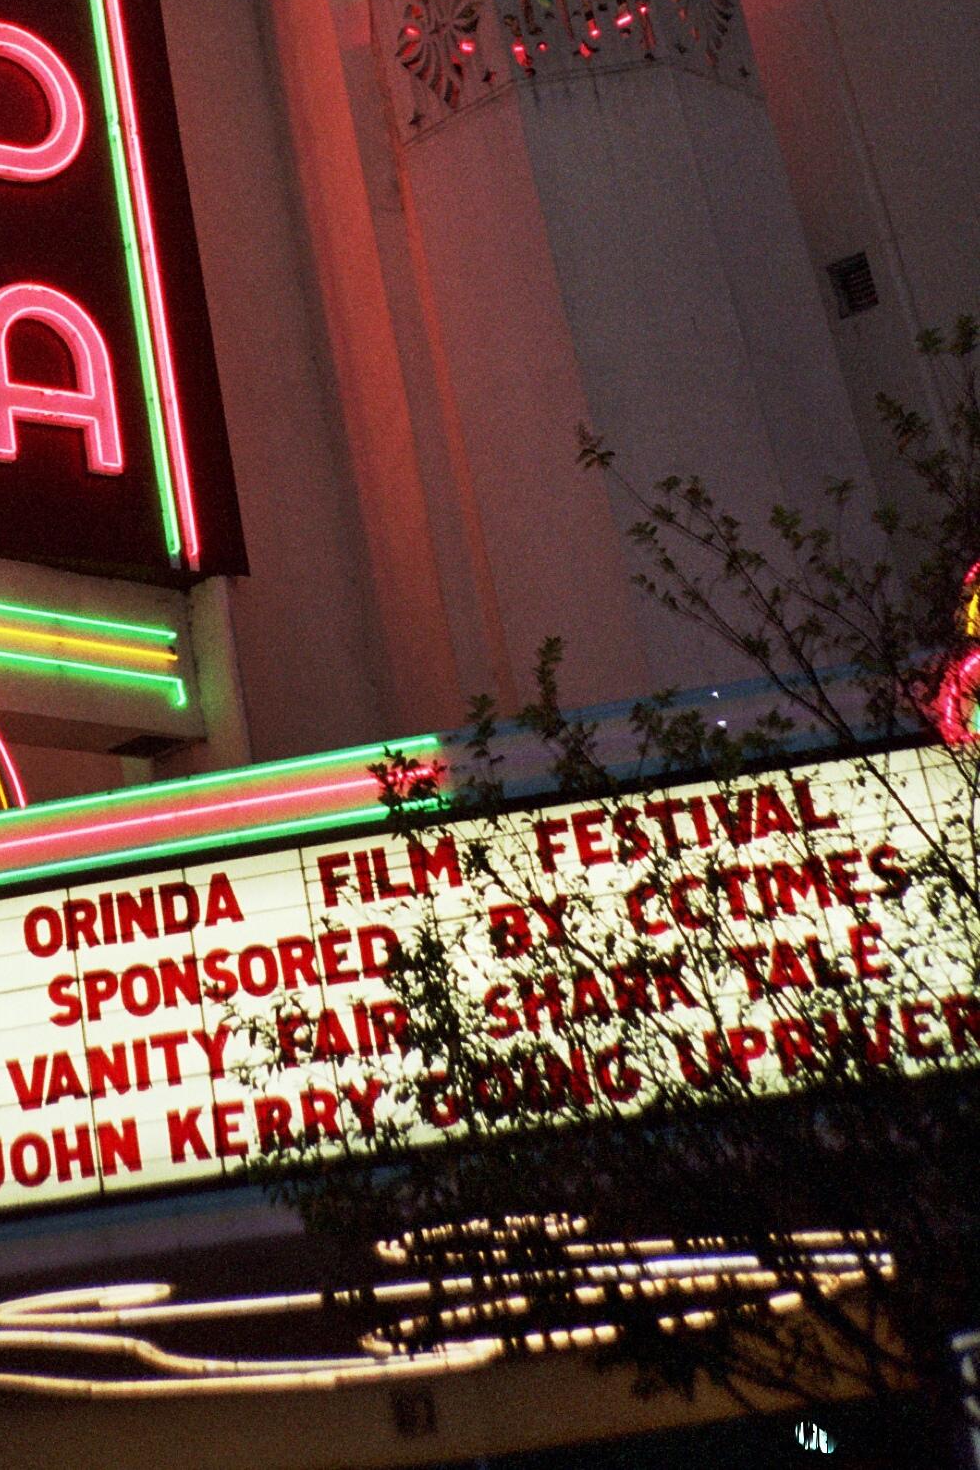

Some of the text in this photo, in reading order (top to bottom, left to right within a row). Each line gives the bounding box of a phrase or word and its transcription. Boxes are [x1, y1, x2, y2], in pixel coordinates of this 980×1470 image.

[23, 872, 244, 958] ORINDA
[317, 835, 464, 908] FILM
[533, 779, 840, 874] FESTIVAL
[6, 1022, 233, 1113] VANITY
[277, 998, 411, 1069] FAIR
[483, 954, 702, 1040] SHARK
[726, 922, 893, 1002] TALE
[47, 923, 403, 1028] SPONSORED
[488, 894, 569, 959] BY
[166, 1076, 386, 1166] KERRY
